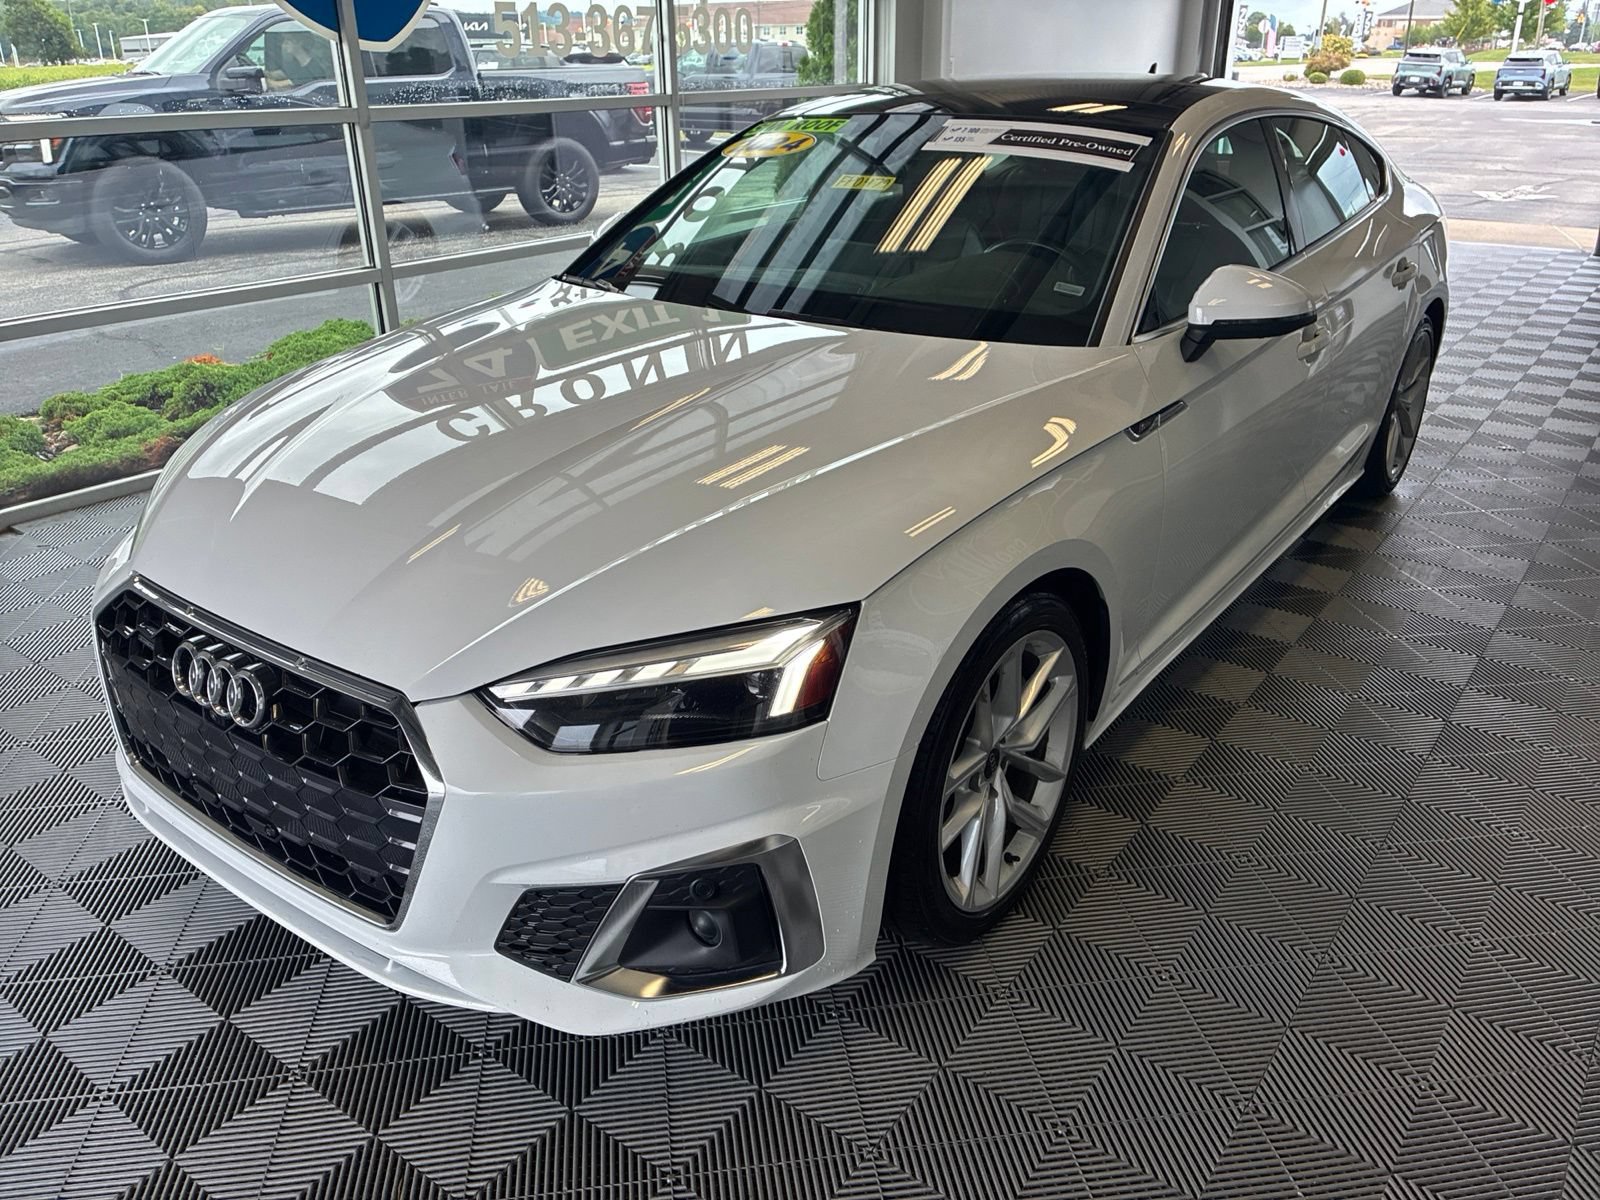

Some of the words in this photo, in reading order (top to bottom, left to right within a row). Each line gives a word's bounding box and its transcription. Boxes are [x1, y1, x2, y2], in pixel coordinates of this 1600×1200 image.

[493, 1, 753, 58] 513-3675300
[1000, 133, 1056, 146] Certified
[1060, 139, 1135, 157] Pre-Owned
